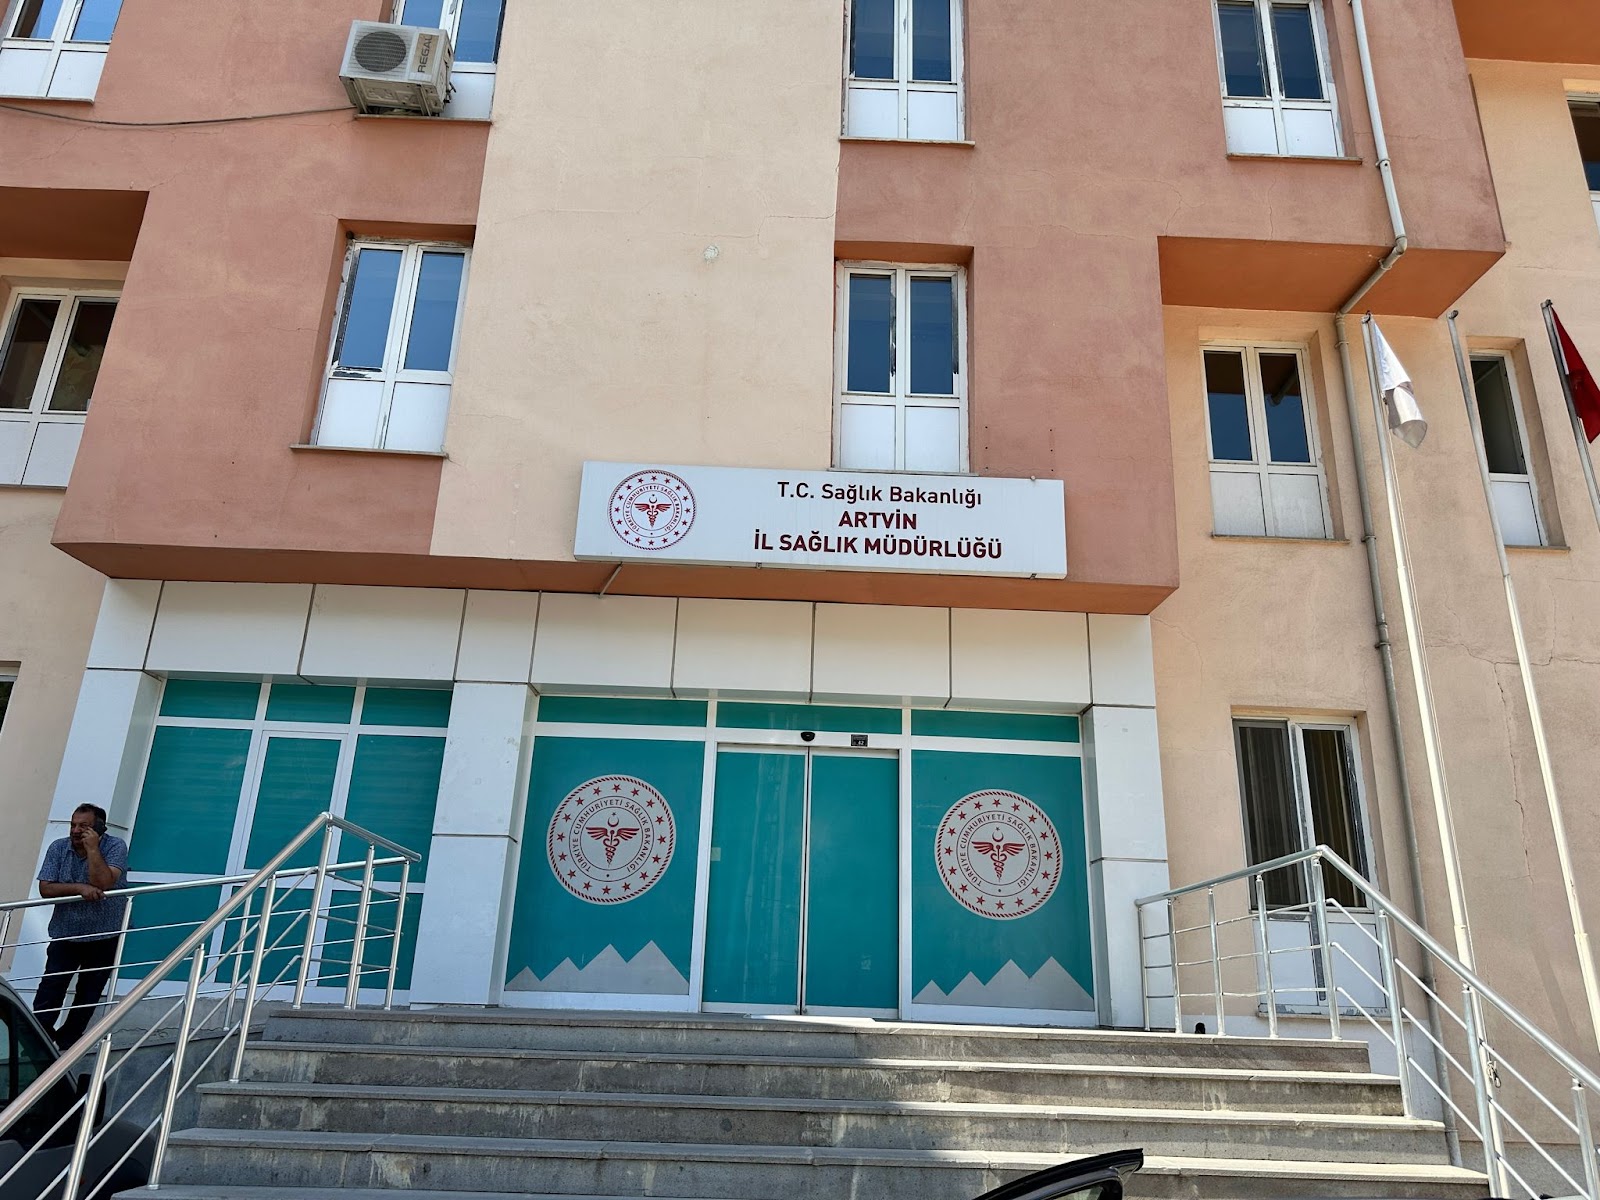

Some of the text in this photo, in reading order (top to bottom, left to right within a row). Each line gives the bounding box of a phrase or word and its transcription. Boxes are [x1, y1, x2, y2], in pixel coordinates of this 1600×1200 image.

[417, 35, 432, 73] REGAL
[777, 481, 981, 508] T.C. Sağlık Bakanlığı
[838, 509, 917, 530] ARTVİN
[754, 529, 1002, 559] İL SAĞLIK MÜDÜRLÜĞÜ
[572, 799, 651, 873] TÜRKİYE CUMHURİYETİ SAĞLIK BAKANLIĞI
[960, 814, 1037, 888] TÜRKİYE CUMHURİYETİ SAĞLIK BAKANLIĞI
